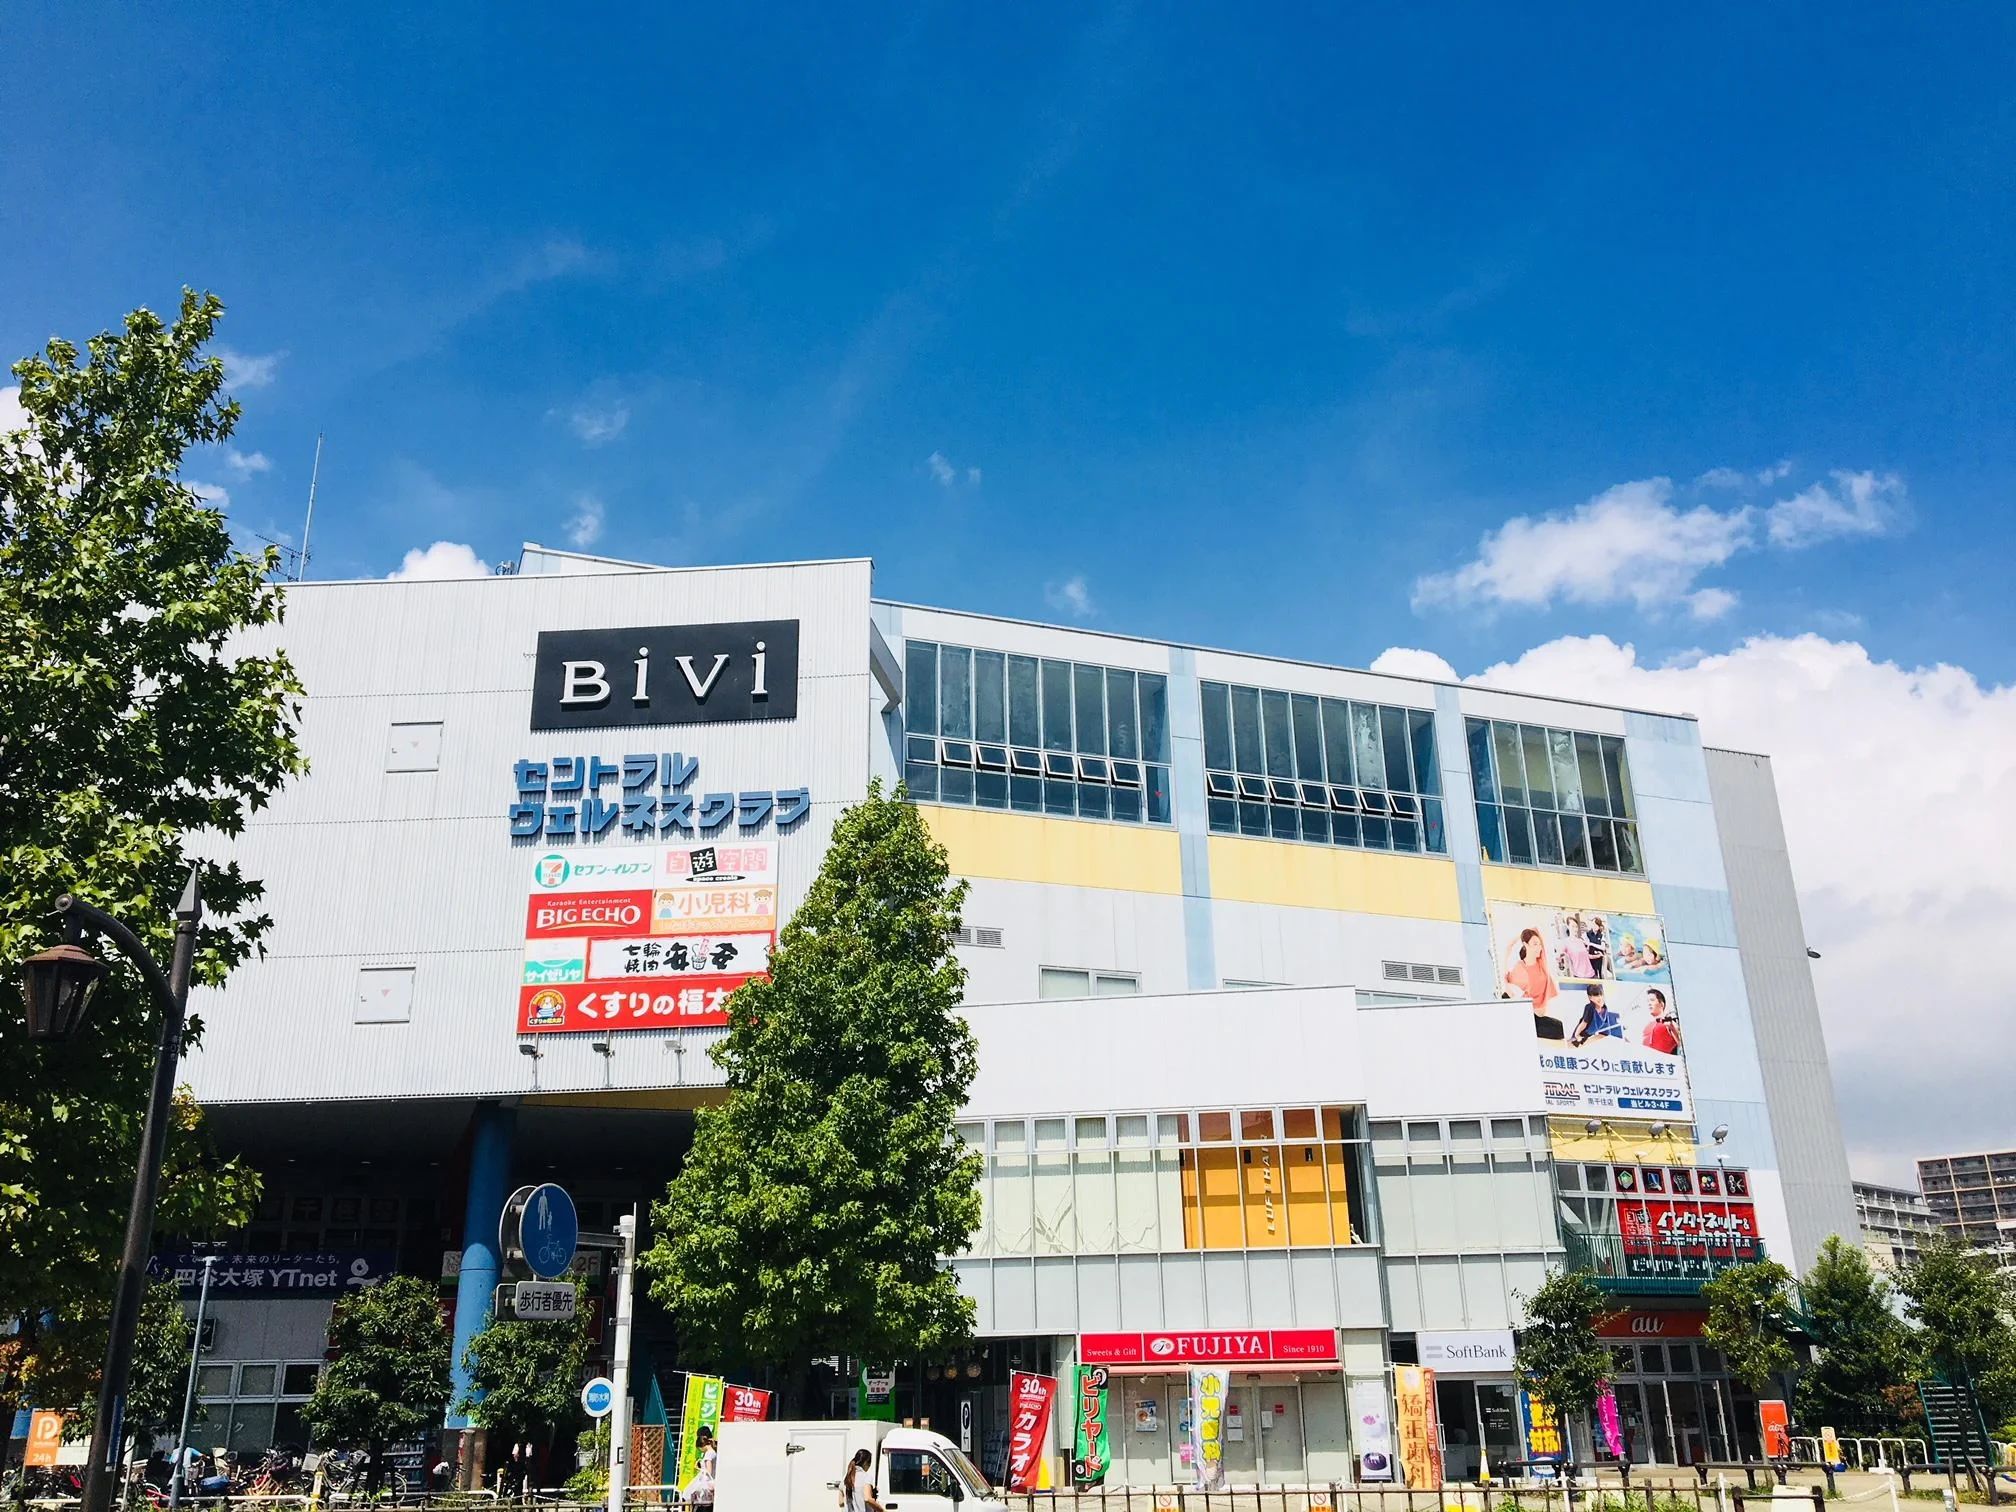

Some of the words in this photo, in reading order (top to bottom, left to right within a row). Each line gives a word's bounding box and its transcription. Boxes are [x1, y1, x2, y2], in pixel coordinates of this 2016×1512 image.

[559, 640, 769, 704] BiVi
[513, 753, 698, 792] セントラル
[508, 787, 810, 837] ウェルネスクラブ
[667, 847, 768, 875] 自遊空間
[579, 898, 631, 906] Entertainment
[678, 891, 751, 916] 小児科
[536, 908, 578, 929] BIG
[581, 905, 641, 925] ECHO
[622, 942, 662, 958] 七輪
[525, 968, 582, 982] サイゼリヤ
[624, 958, 659, 973] 焼肉
[268, 1268, 338, 1287] YTnet
[520, 1291, 573, 1312] 歩行者優先
[1631, 1316, 1664, 1333] au
[1123, 1348, 1137, 1356] Gift
[1177, 1335, 1264, 1355] FUJIYA
[1283, 1345, 1305, 1353] Since
[1307, 1344, 1325, 1352] 1910
[1446, 1344, 1507, 1359] SoftBank
[1020, 1378, 1047, 1395] 30th
[734, 1391, 761, 1408] 30th
[1081, 1374, 1102, 1478] ビリヤード
[1010, 1411, 1037, 1488] カラオケ
[1401, 1394, 1425, 1488] 矯正歯科
